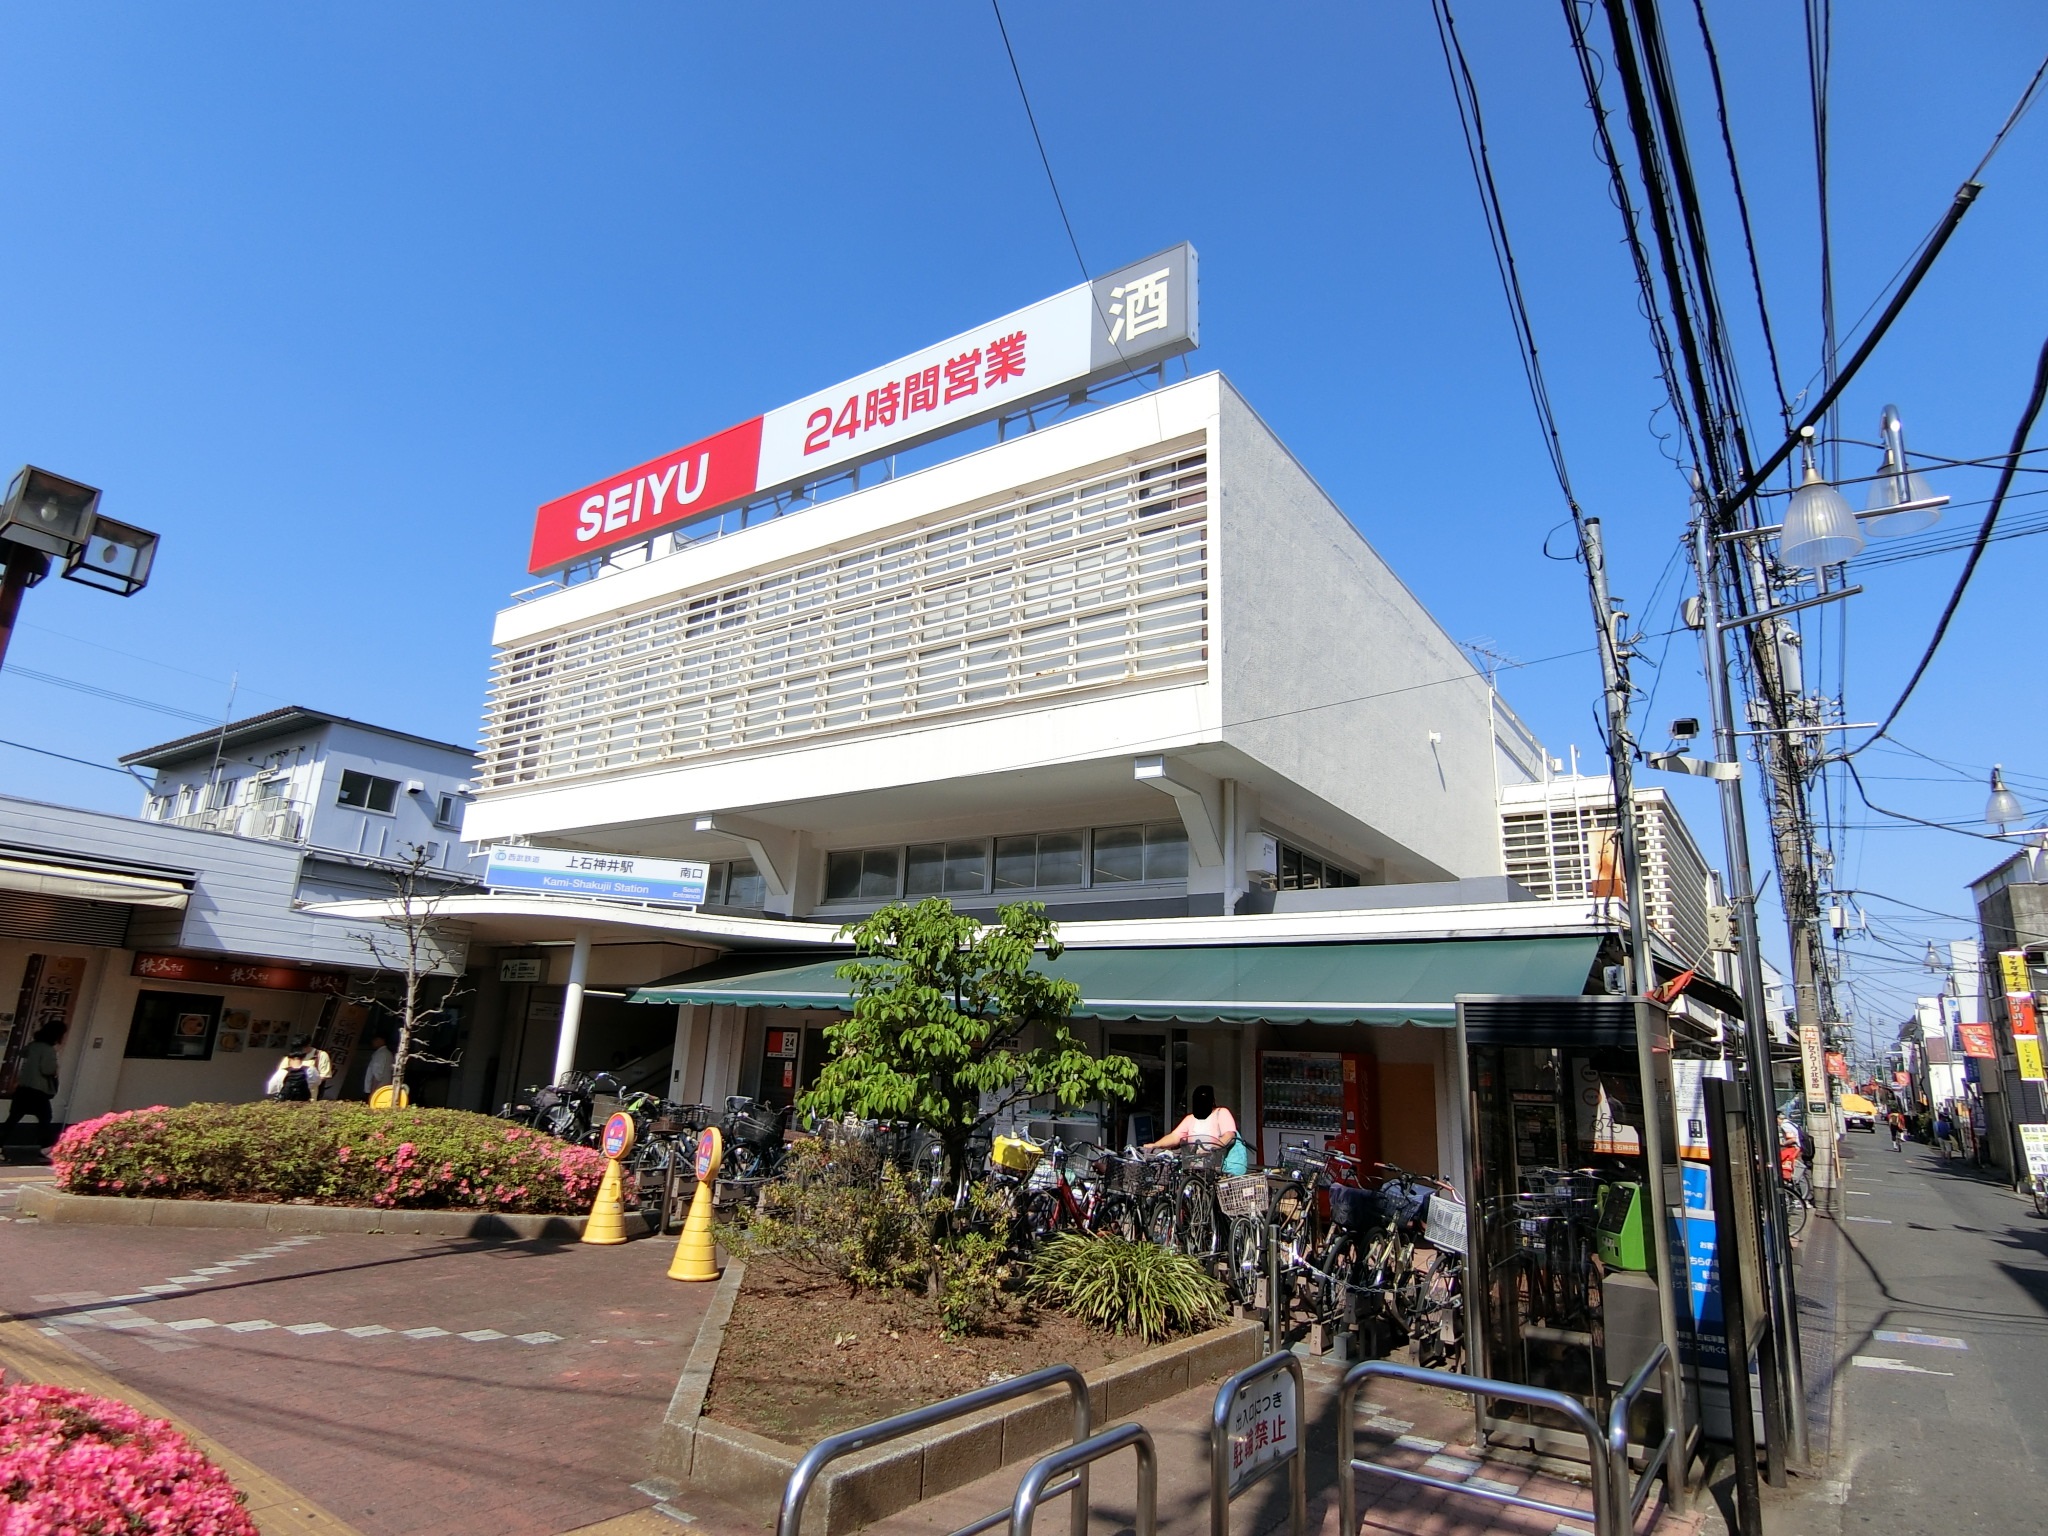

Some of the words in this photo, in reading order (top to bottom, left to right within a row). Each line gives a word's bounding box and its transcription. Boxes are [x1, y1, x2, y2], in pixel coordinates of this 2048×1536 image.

[1107, 267, 1170, 346] 酒
[803, 330, 1027, 456] 24時間営業
[575, 452, 709, 543] SEIYU
[507, 853, 540, 864] 西武鉄道
[565, 855, 634, 874] 上石神井駅
[679, 867, 703, 880] 南口
[543, 876, 612, 892] Kami-Shakujii
[613, 882, 649, 894] Station
[682, 886, 702, 894] South
[672, 891, 702, 900] Entrance
[784, 1037, 795, 1047] 24
[1236, 1391, 1282, 1432] 出入口につき
[1233, 1414, 1287, 1470] 駐輪禁止
